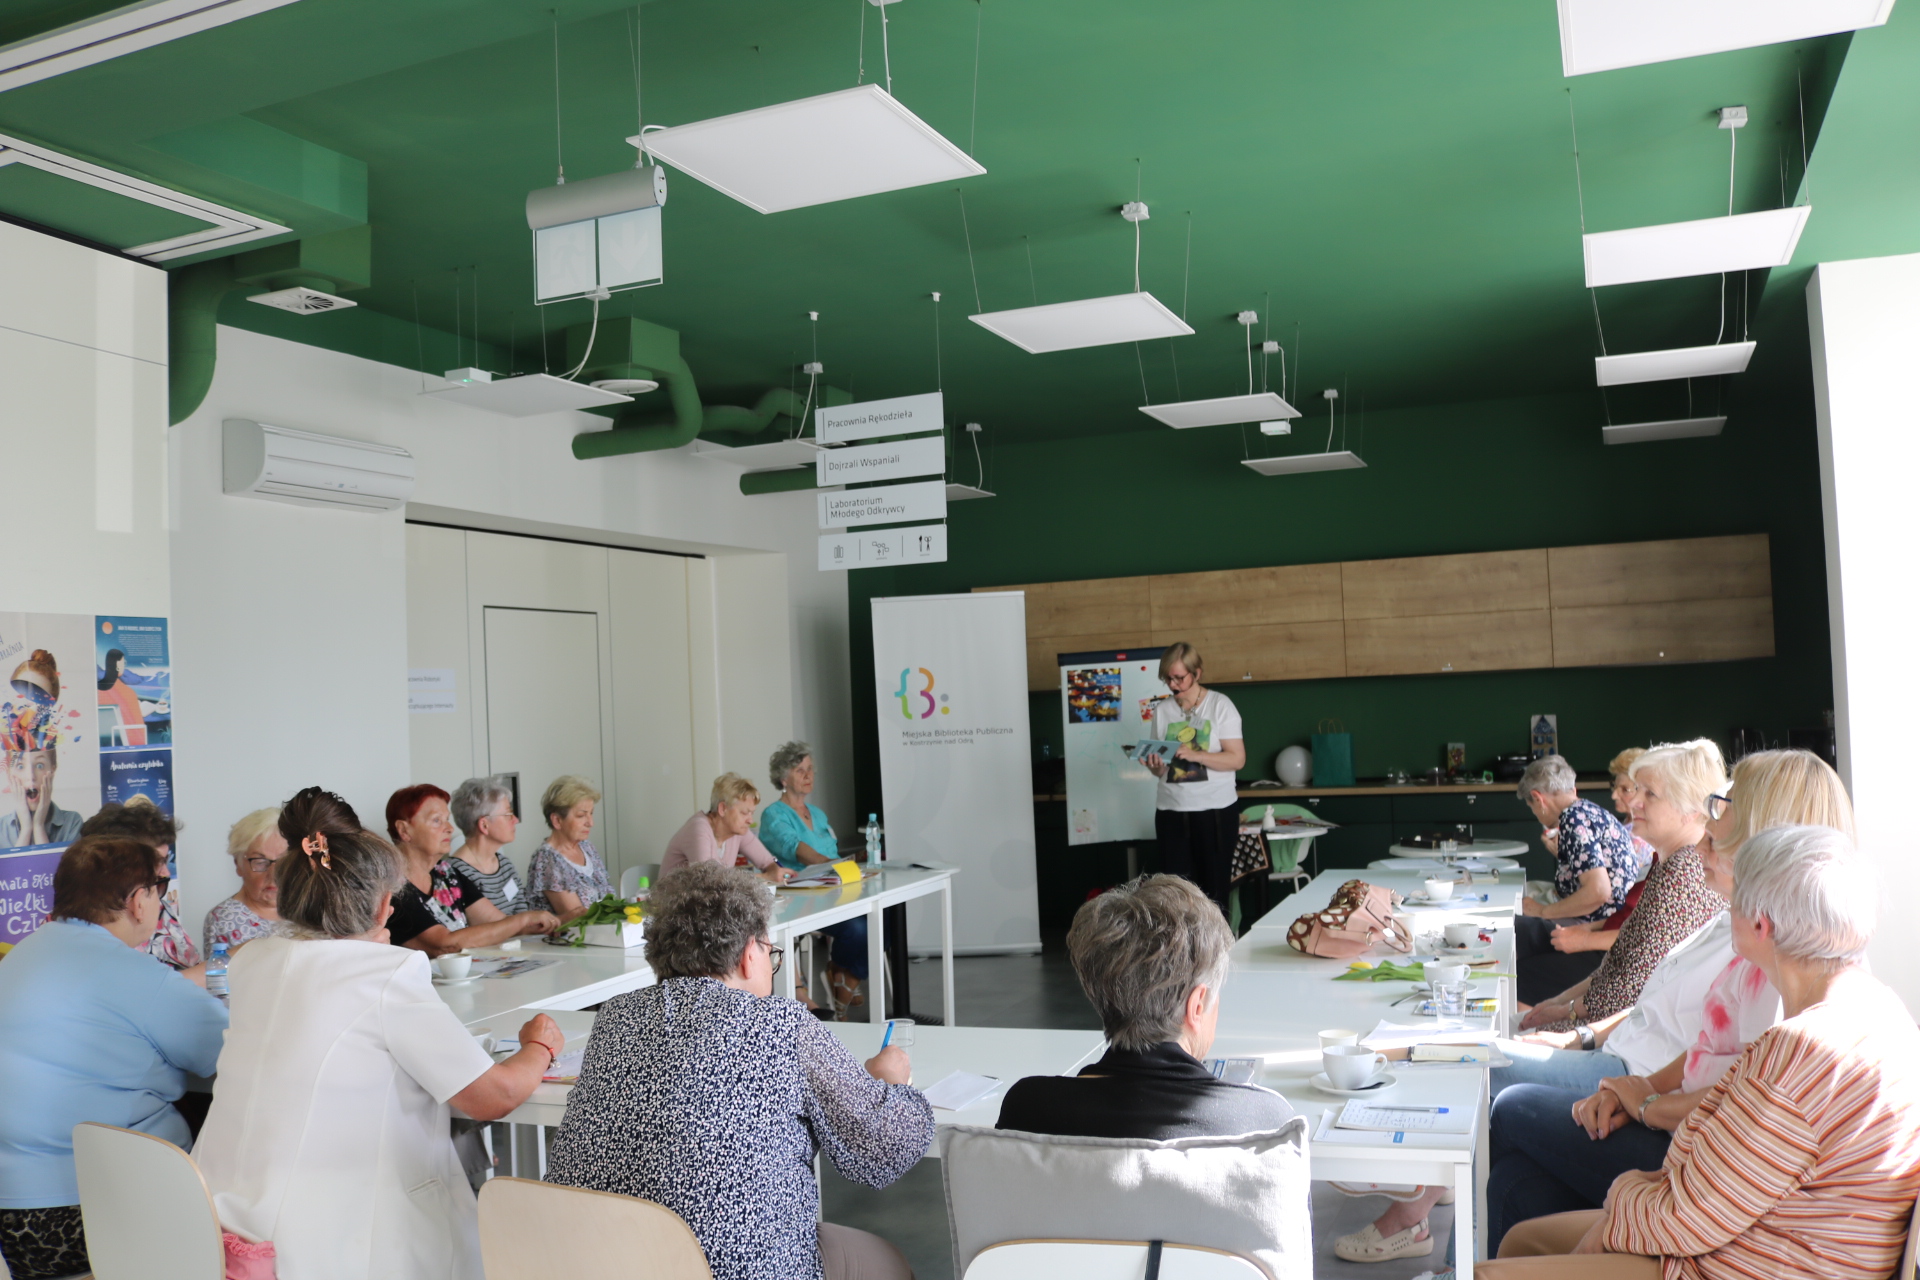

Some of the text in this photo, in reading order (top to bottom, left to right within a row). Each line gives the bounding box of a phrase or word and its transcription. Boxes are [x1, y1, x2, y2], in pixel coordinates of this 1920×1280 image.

[828, 410, 913, 428] Pracownia Rękodzieła
[828, 455, 900, 472] Dojrzali Wspaniali
[830, 497, 883, 509] Laboratorium
[830, 505, 905, 519] Młodego Odkrywcy
[902, 727, 1013, 739] Miejska Biblioteka Publiczna
[32, 873, 54, 890] Ksi
